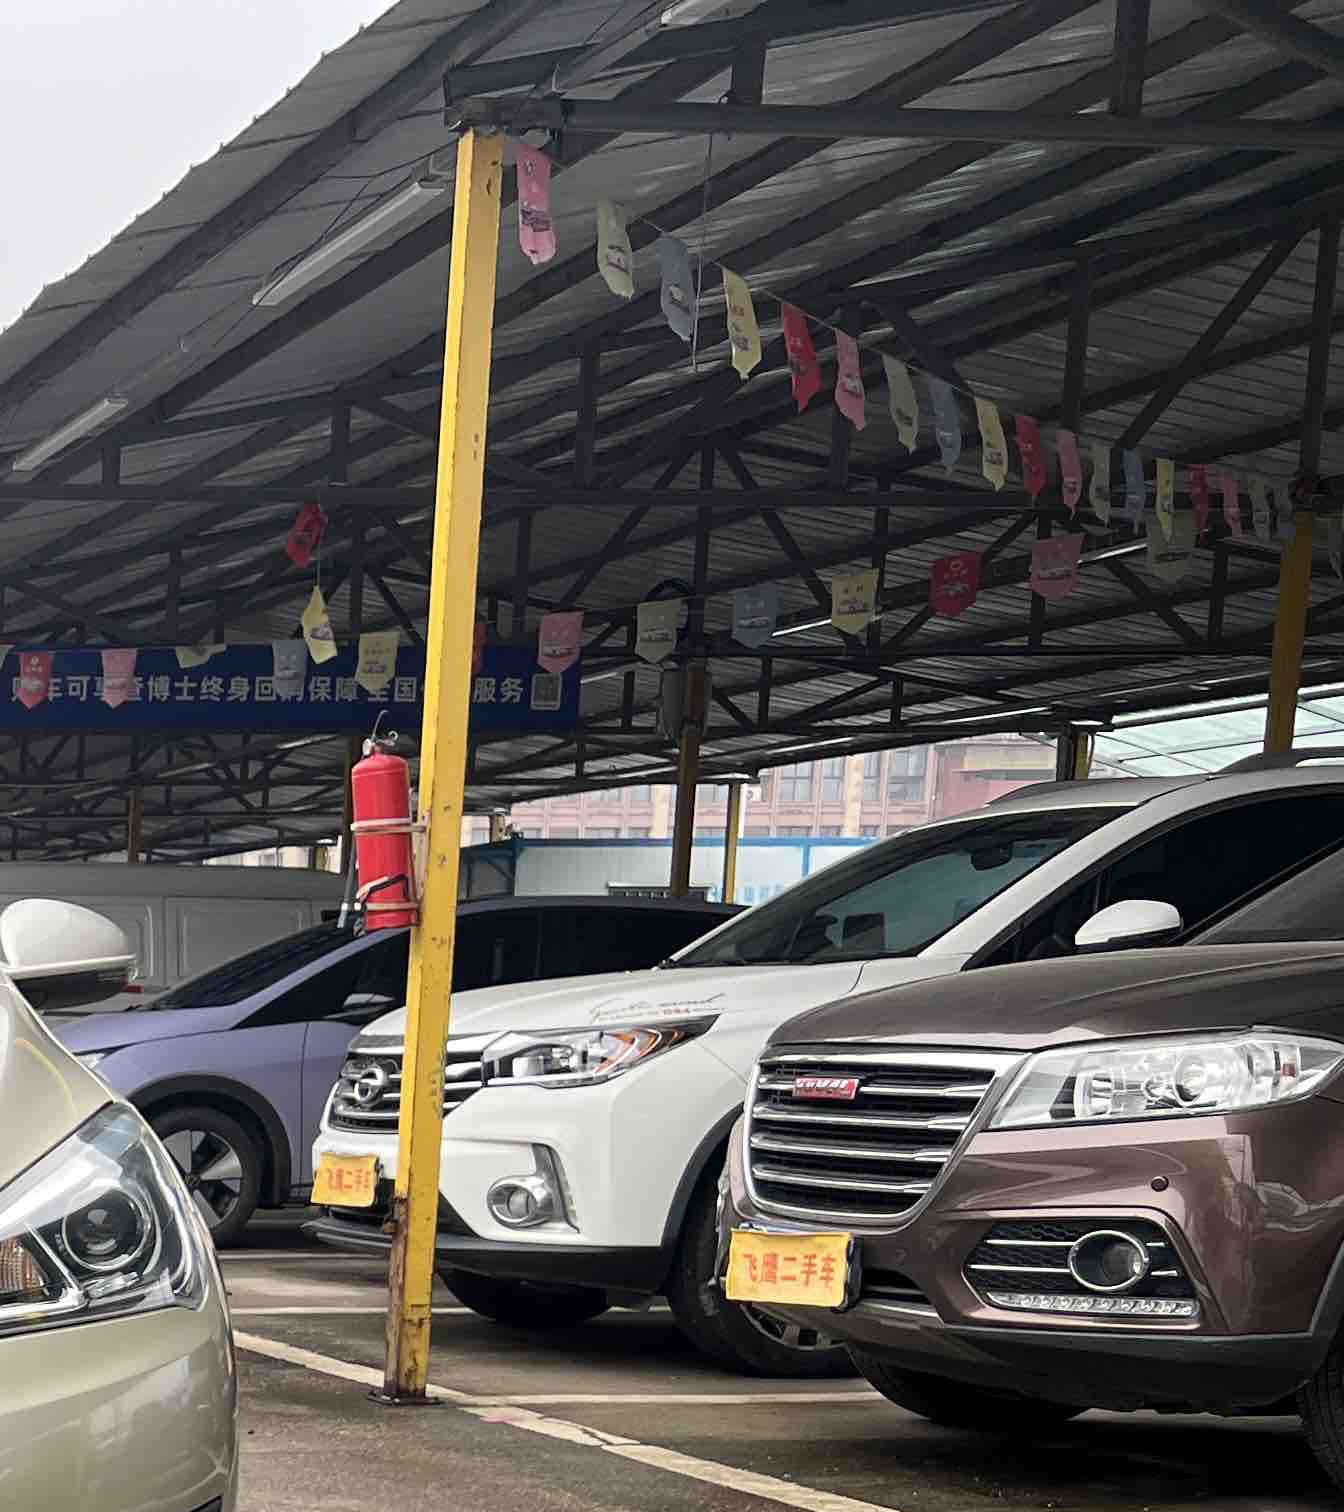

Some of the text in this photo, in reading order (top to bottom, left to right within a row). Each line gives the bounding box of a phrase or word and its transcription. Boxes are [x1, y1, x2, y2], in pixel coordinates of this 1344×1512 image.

[325, 1167, 373, 1193] 飞鹰二手车
[743, 1252, 837, 1288] 飞鹰二手车
